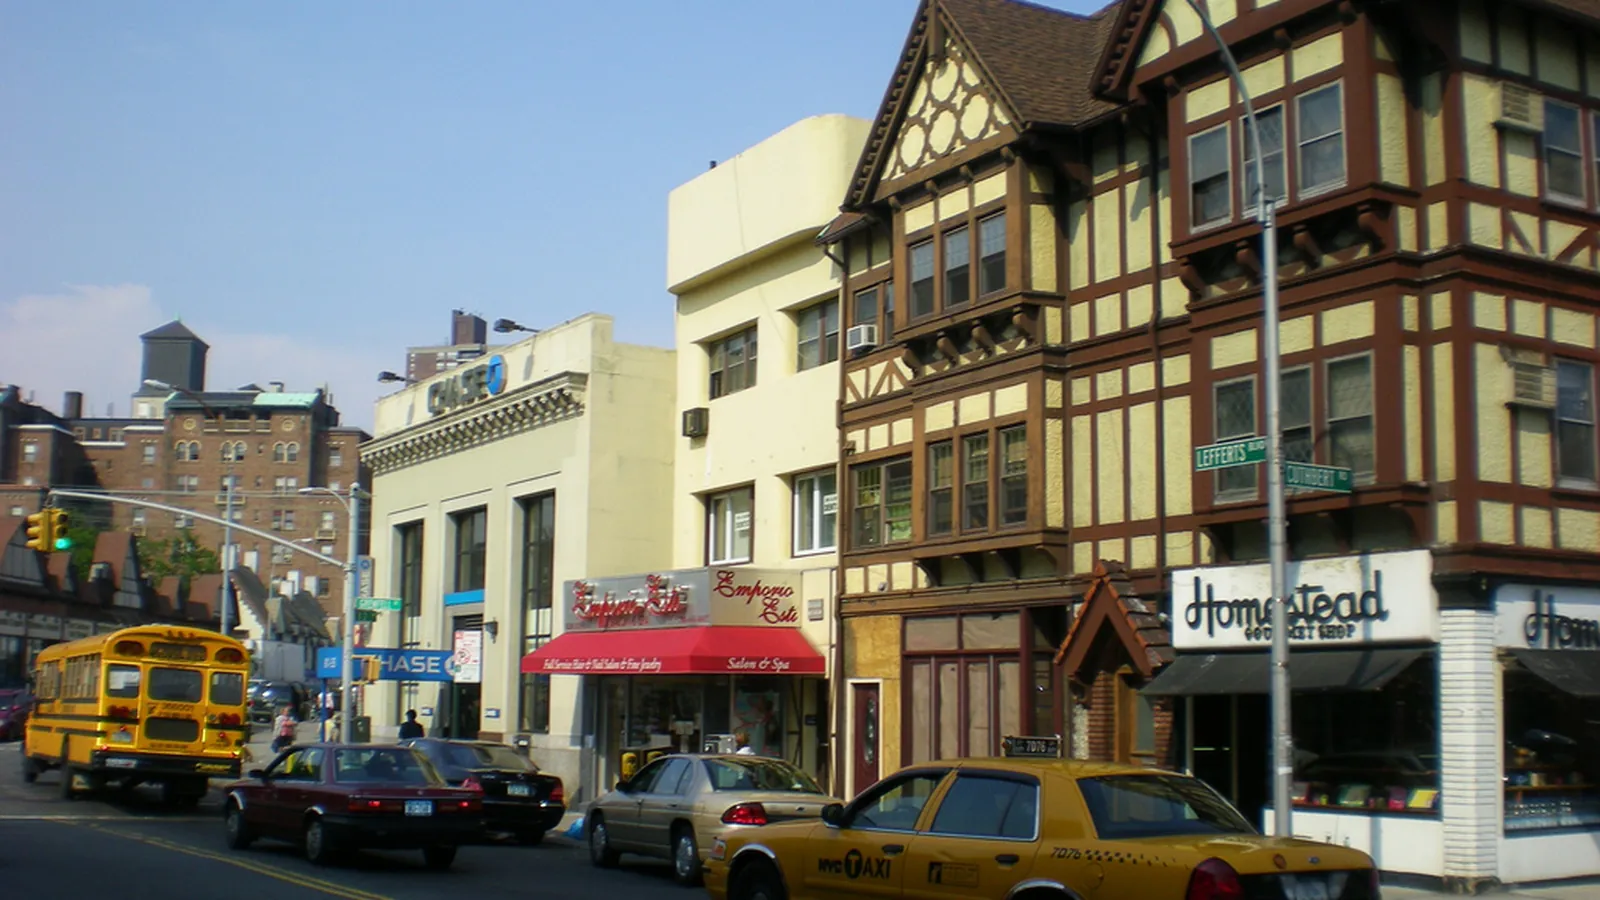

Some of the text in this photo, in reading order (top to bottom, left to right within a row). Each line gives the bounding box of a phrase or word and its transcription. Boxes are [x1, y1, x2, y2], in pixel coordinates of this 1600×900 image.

[1196, 443, 1246, 468] LEFFERTS
[1287, 465, 1336, 487] CUTHBERT
[713, 570, 794, 605] Emporio
[758, 596, 798, 624] Esti
[1318, 624, 1356, 641] SHOP
[379, 655, 441, 674] HASE
[727, 657, 790, 673] Salon & Spa
[844, 848, 892, 879] TAXI
